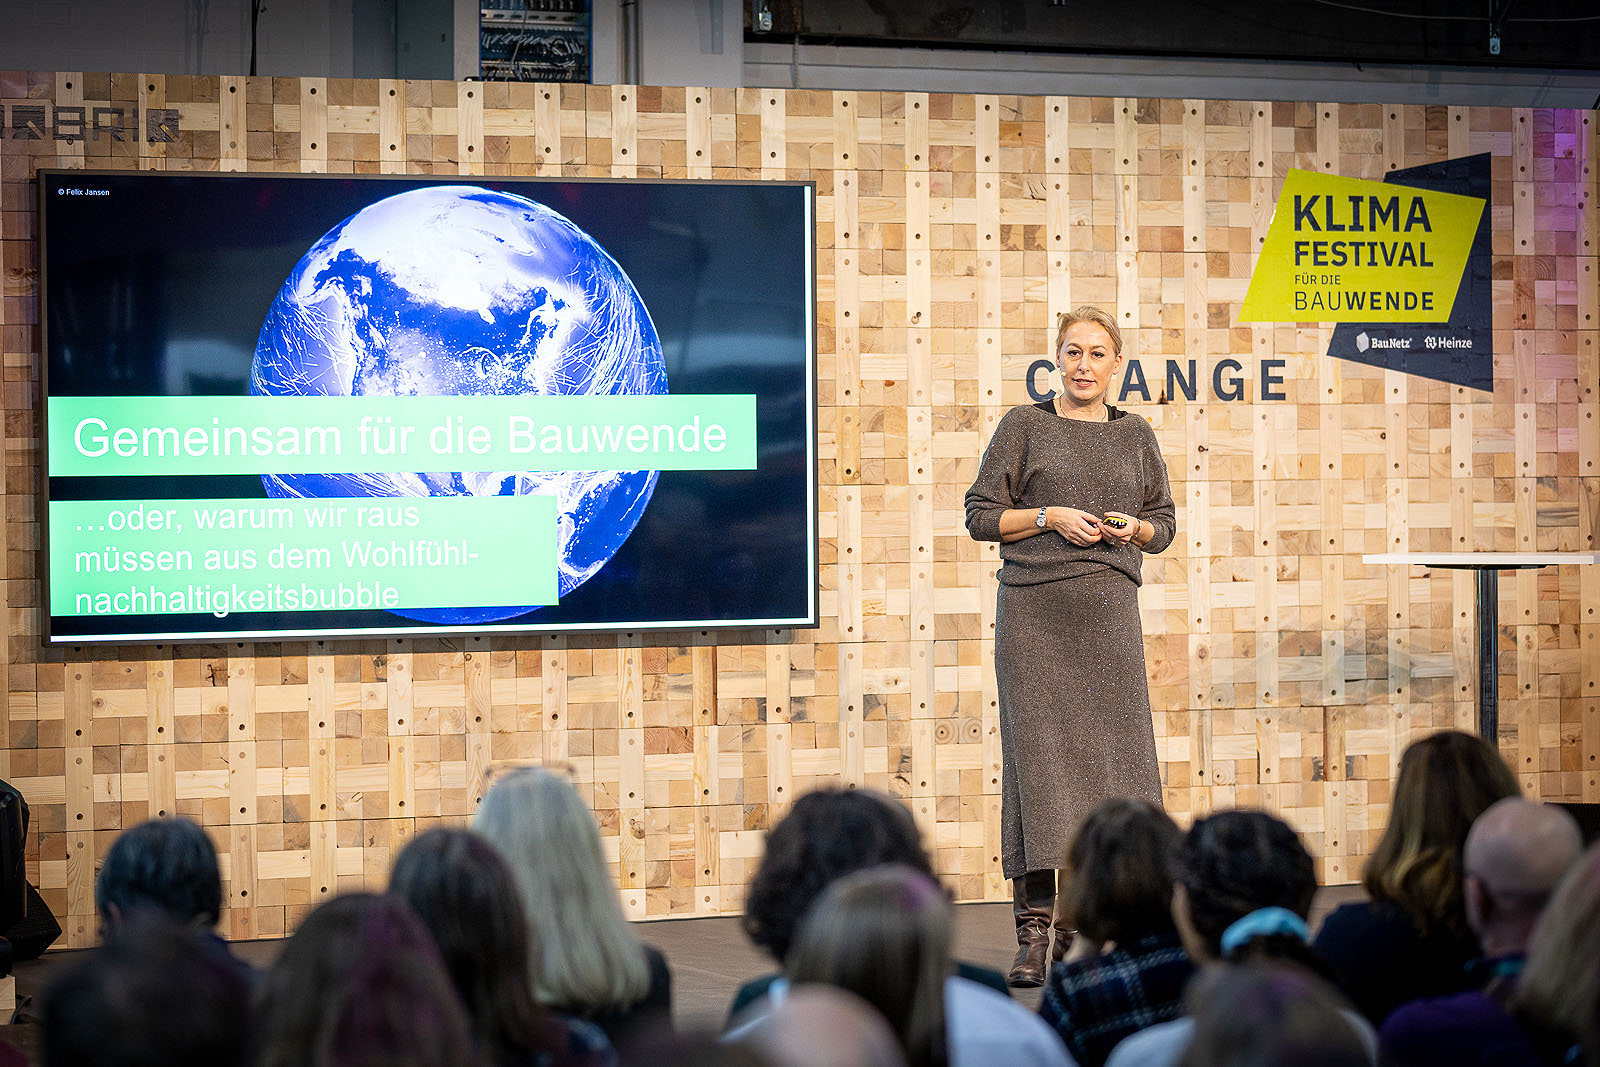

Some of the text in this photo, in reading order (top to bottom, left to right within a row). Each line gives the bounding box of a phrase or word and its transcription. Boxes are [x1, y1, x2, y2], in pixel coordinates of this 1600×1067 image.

[66, 188, 84, 196] Felix
[85, 188, 110, 196] Jansen
[1294, 195, 1432, 232] KLIMA
[1295, 241, 1434, 267] FESTIVAL
[1295, 272, 1341, 285] FÜR DIE
[1295, 291, 1434, 311] BAUWENDE
[1438, 336, 1473, 349] Heinze
[1026, 358, 1286, 402] CANGE
[74, 416, 727, 458] Gemeinsam für die Bauwende
[194, 509, 294, 530] warum
[304, 501, 347, 528] wir
[357, 507, 420, 528] raus
[75, 540, 479, 573] müssen aus dem Wohlfühl-
[75, 582, 399, 618] nachhaltigkeitsbubble
